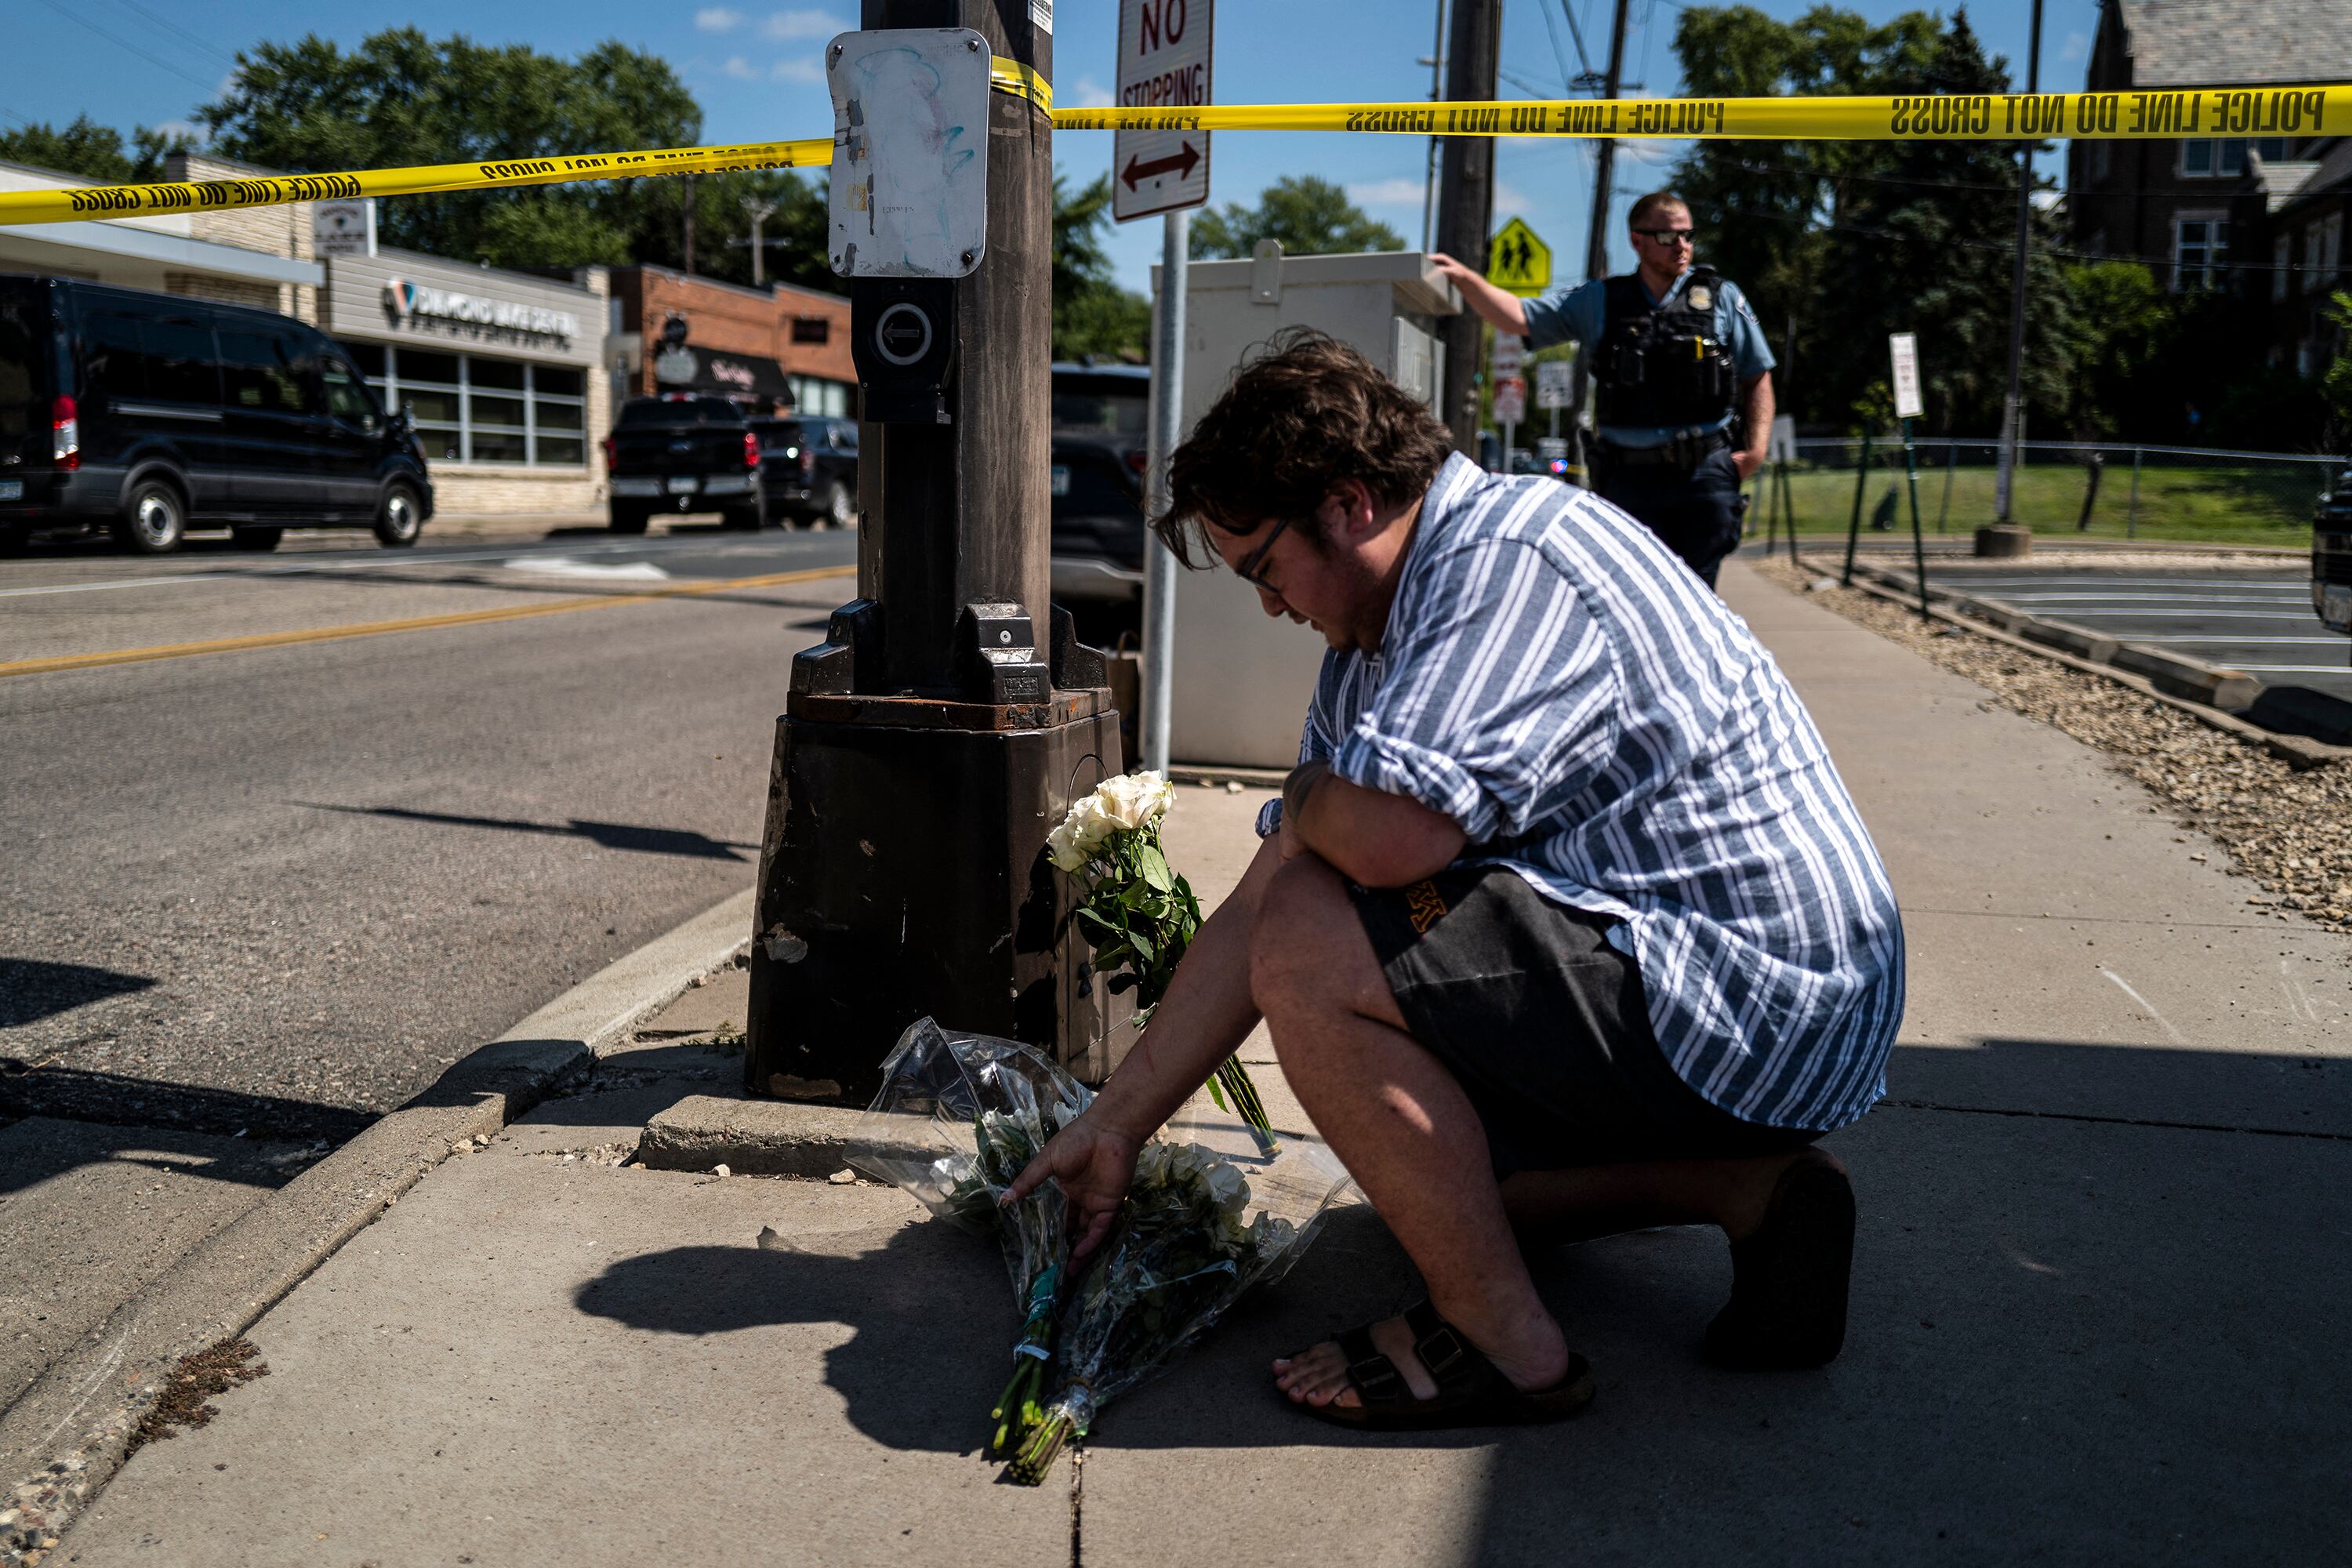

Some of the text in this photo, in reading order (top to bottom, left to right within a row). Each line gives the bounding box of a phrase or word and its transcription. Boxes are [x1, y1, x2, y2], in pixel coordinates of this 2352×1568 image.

[1140, 0, 1186, 56] NO
[62, 175, 361, 212] POLICE LINE DO NOT CROSS
